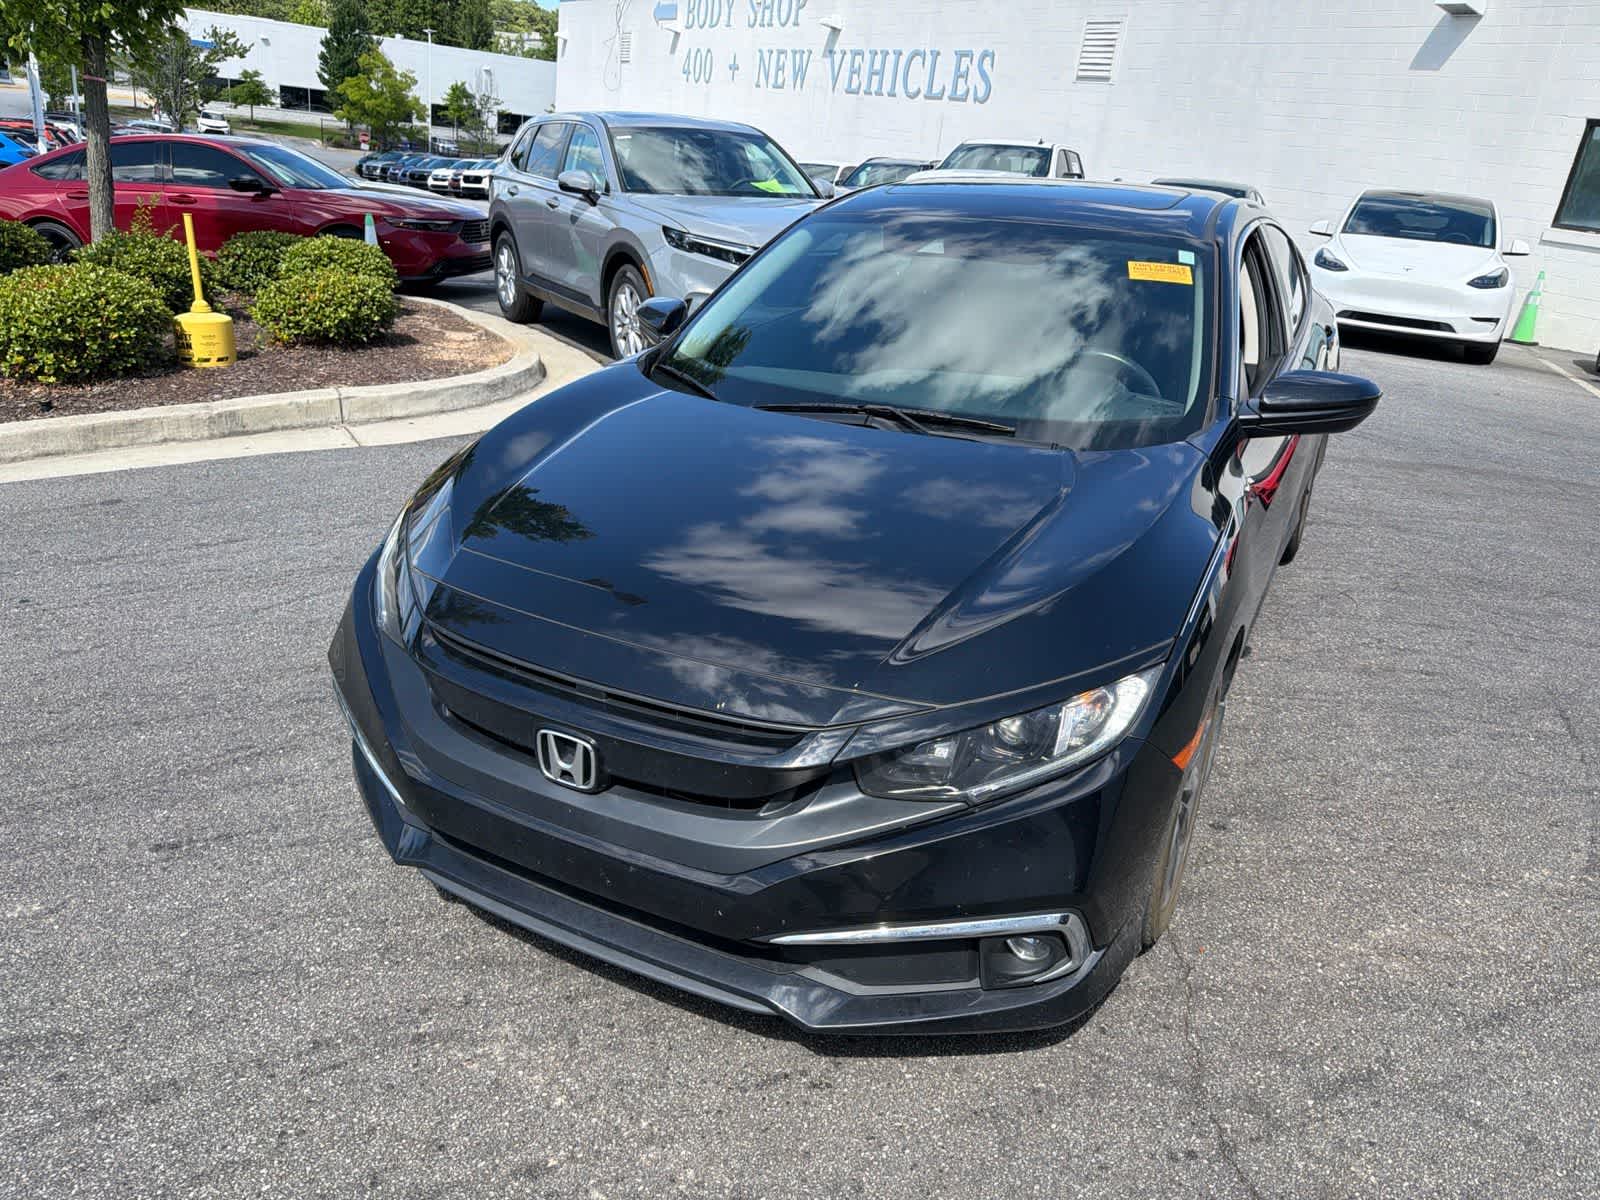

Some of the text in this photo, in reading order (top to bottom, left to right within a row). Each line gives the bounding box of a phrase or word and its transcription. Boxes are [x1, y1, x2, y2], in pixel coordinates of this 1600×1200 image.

[685, 0, 808, 29] BODY SHOP
[682, 48, 995, 104] 400 + NEW VEHICLES
